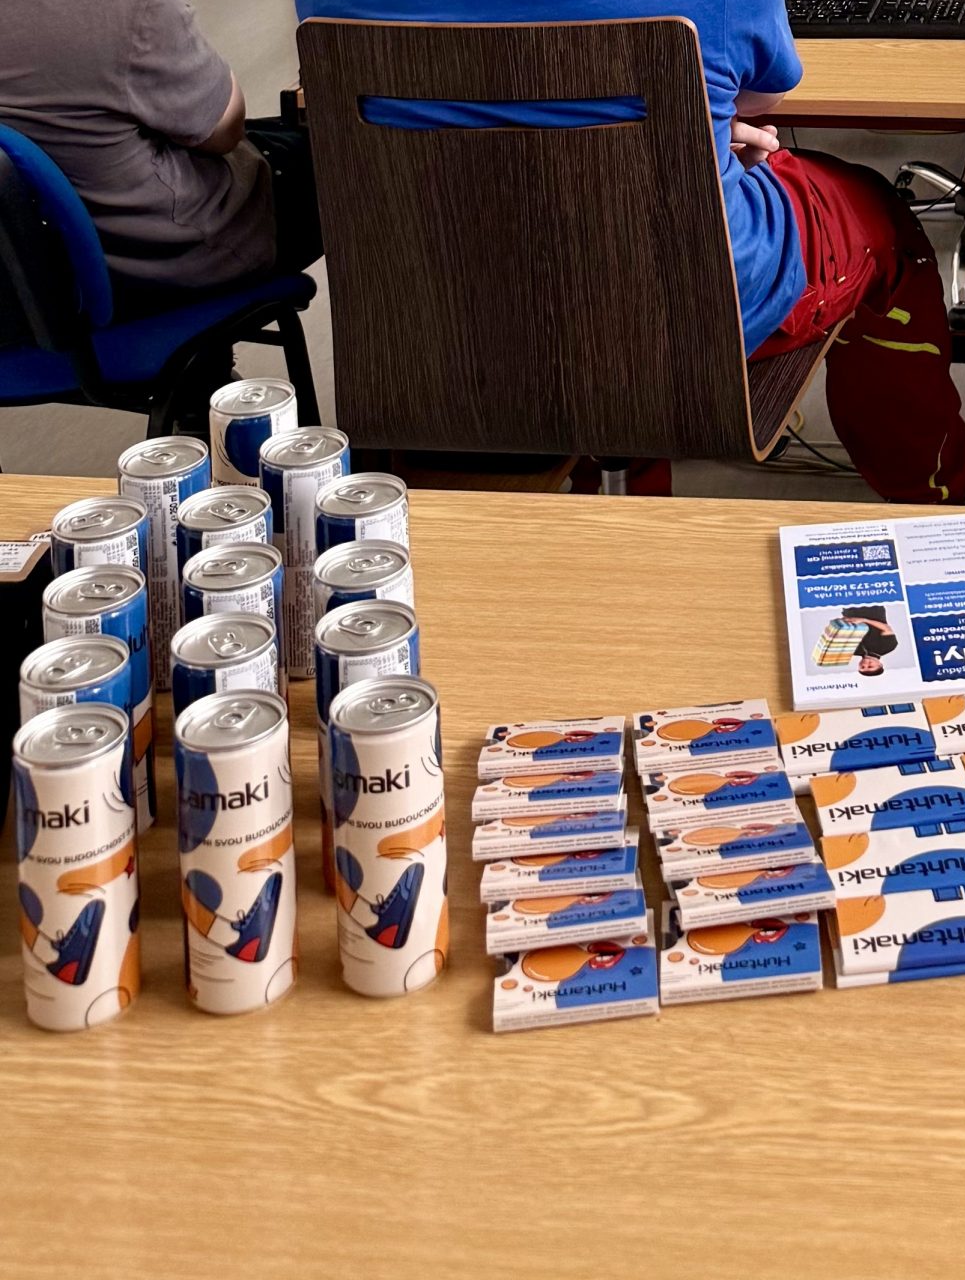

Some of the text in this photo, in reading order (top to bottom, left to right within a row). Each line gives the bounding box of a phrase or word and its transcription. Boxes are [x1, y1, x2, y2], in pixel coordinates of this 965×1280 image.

[804, 581, 895, 593] 160-173 Kč/hod.
[856, 586, 897, 597] Vyděláš
[806, 683, 859, 692] Huhtamaki
[512, 745, 596, 758] Huhtamaki
[668, 737, 751, 752] Huhtamaki
[791, 732, 923, 757] Huhtamaki
[681, 790, 767, 807] Huhtamaki
[828, 792, 965, 823] Huhtamaki
[356, 820, 382, 829] SVOU
[214, 838, 243, 848] SVOU
[696, 838, 786, 856] Huhtamaki
[714, 883, 805, 902] Huhtamaki
[698, 955, 792, 975] Huhtamaki
[531, 981, 628, 1002] Huhtamaki
